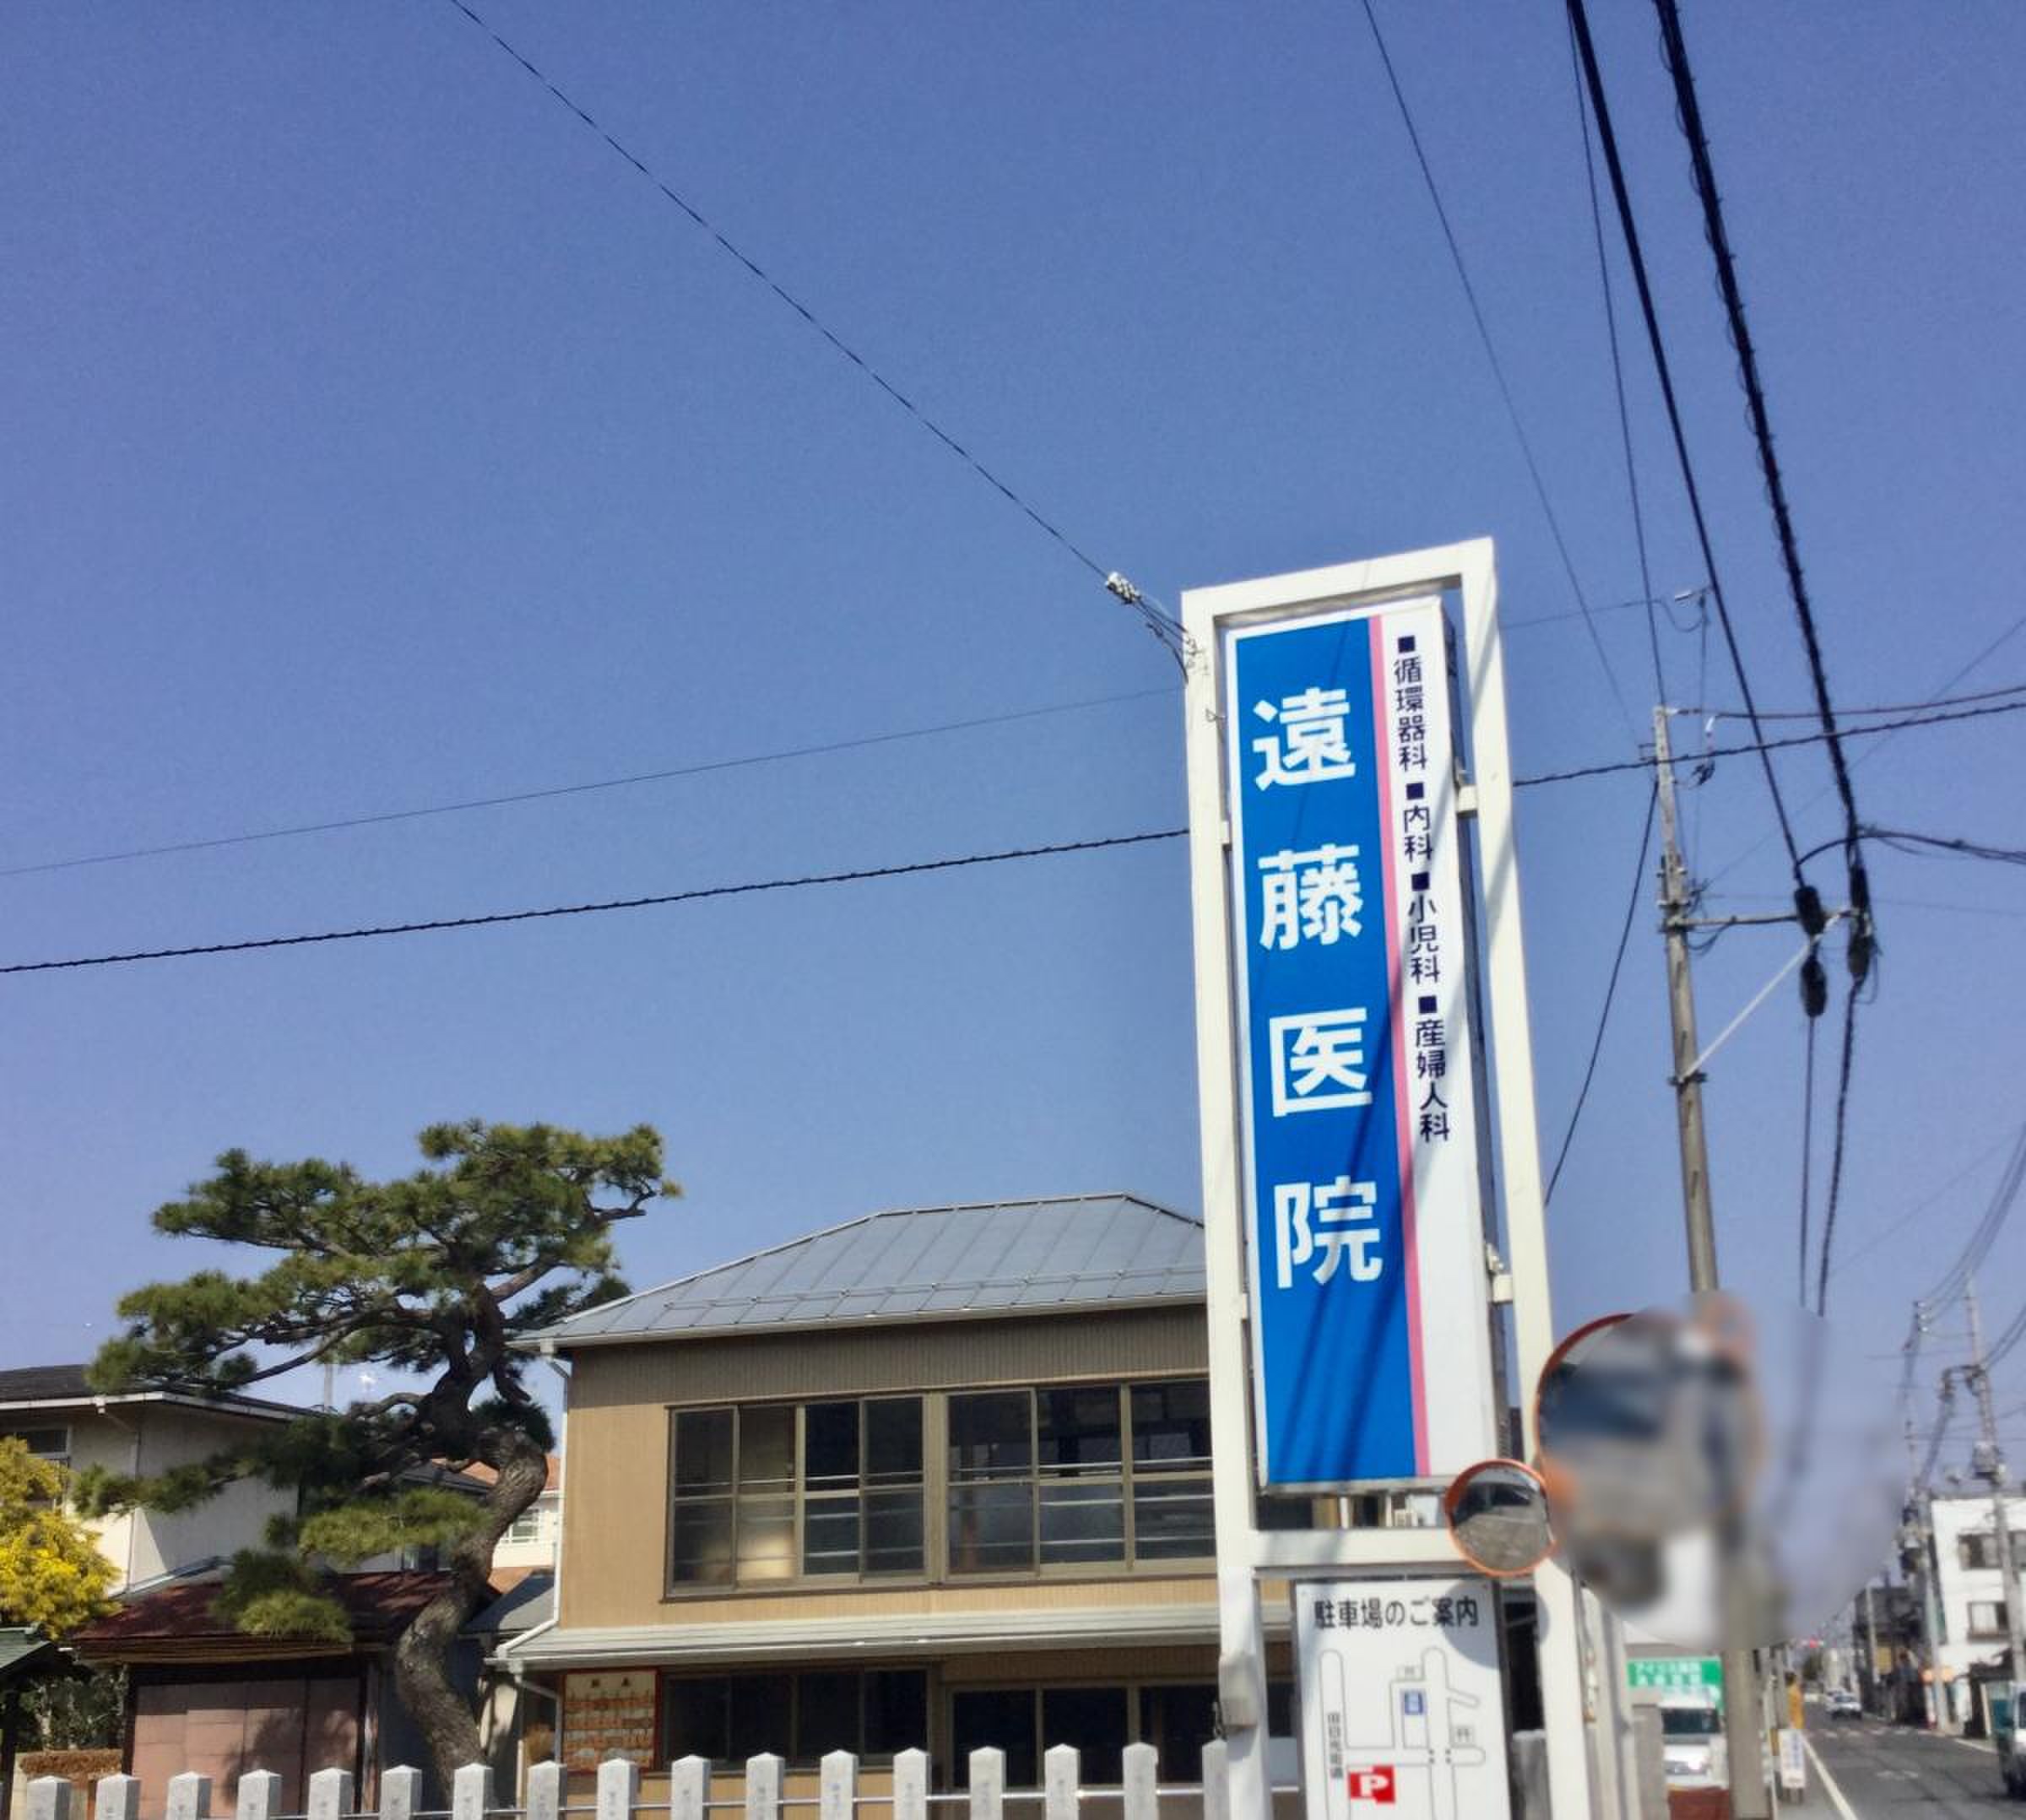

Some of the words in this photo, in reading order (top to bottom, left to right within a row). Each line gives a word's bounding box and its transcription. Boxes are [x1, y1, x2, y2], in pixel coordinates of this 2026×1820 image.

[1394, 655, 1427, 772] 循環器科
[1404, 804, 1433, 864] 内科
[1408, 893, 1441, 985] 小児科
[1252, 686, 1384, 1289] 遠藤医院
[1416, 1019, 1451, 1144] 産婦人科
[1314, 1595, 1479, 1629] 駐車場のご案内
[1358, 1774, 1390, 1797] P
